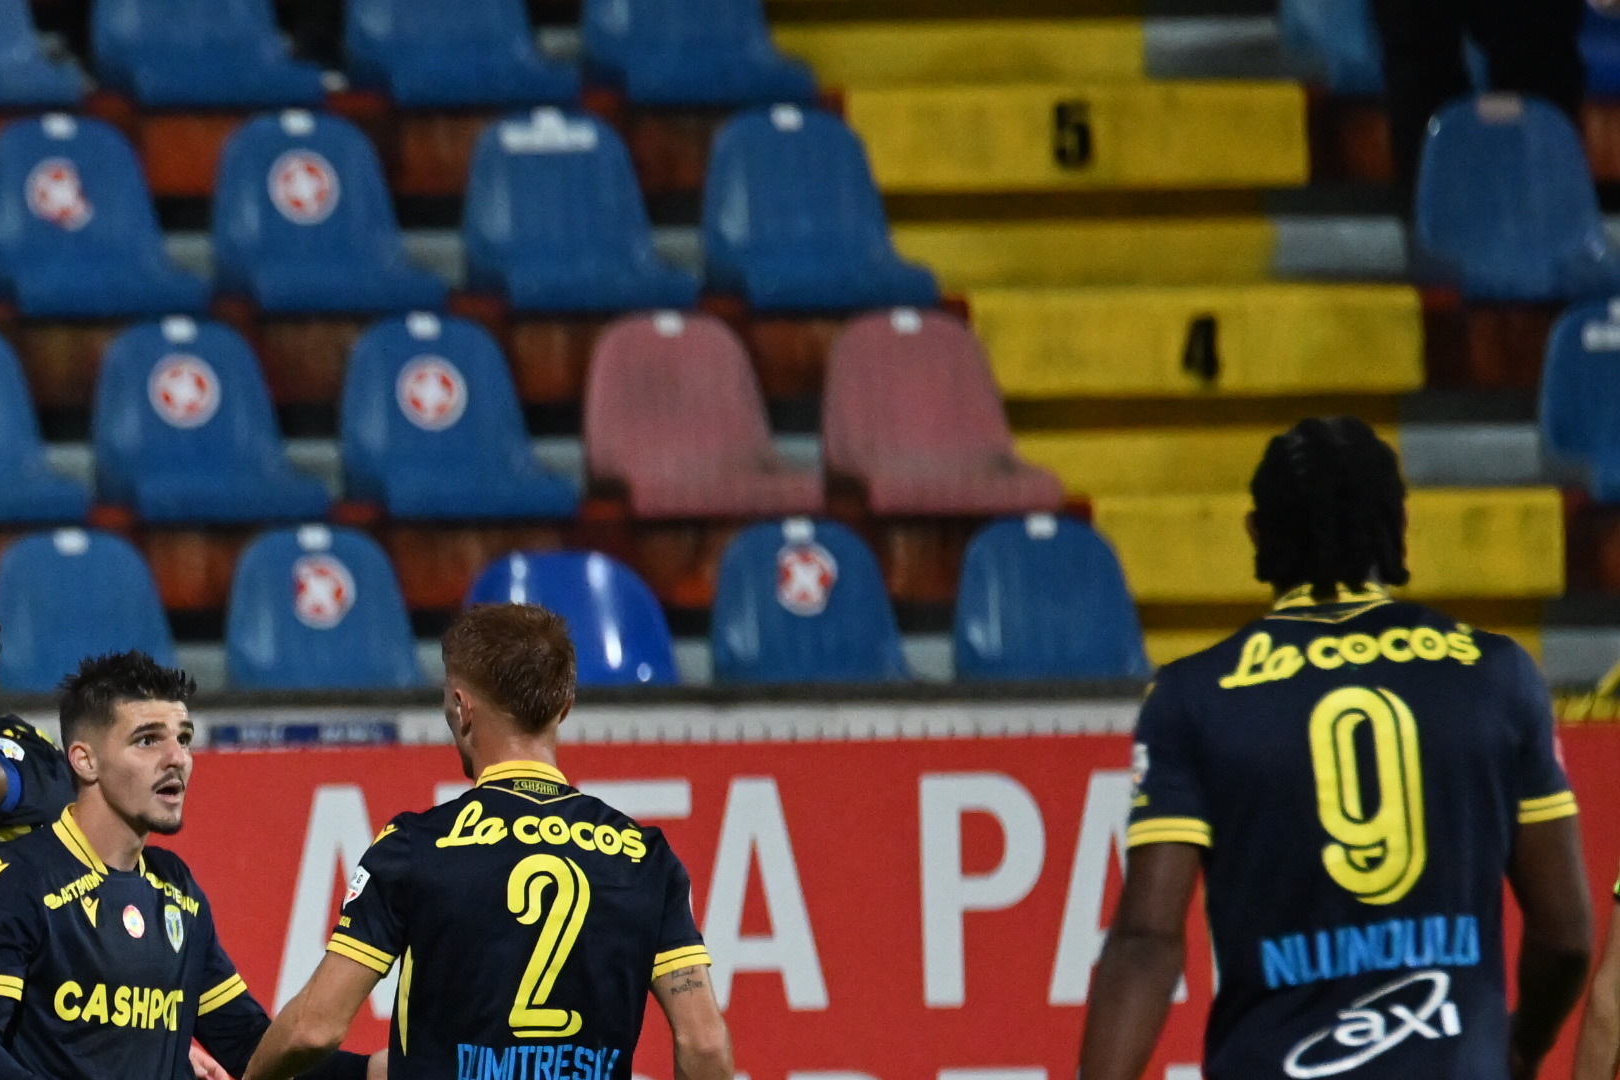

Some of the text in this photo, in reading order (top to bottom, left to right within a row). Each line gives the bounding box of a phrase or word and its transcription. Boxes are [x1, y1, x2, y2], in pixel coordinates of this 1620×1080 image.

[1054, 99, 1093, 170] 5
[1181, 312, 1220, 382] 4
[1218, 632, 1303, 690] La
[435, 801, 508, 848] La
[1308, 686, 1427, 906] 9
[507, 853, 591, 1038] 2
[54, 980, 184, 1032] CASHPOT
